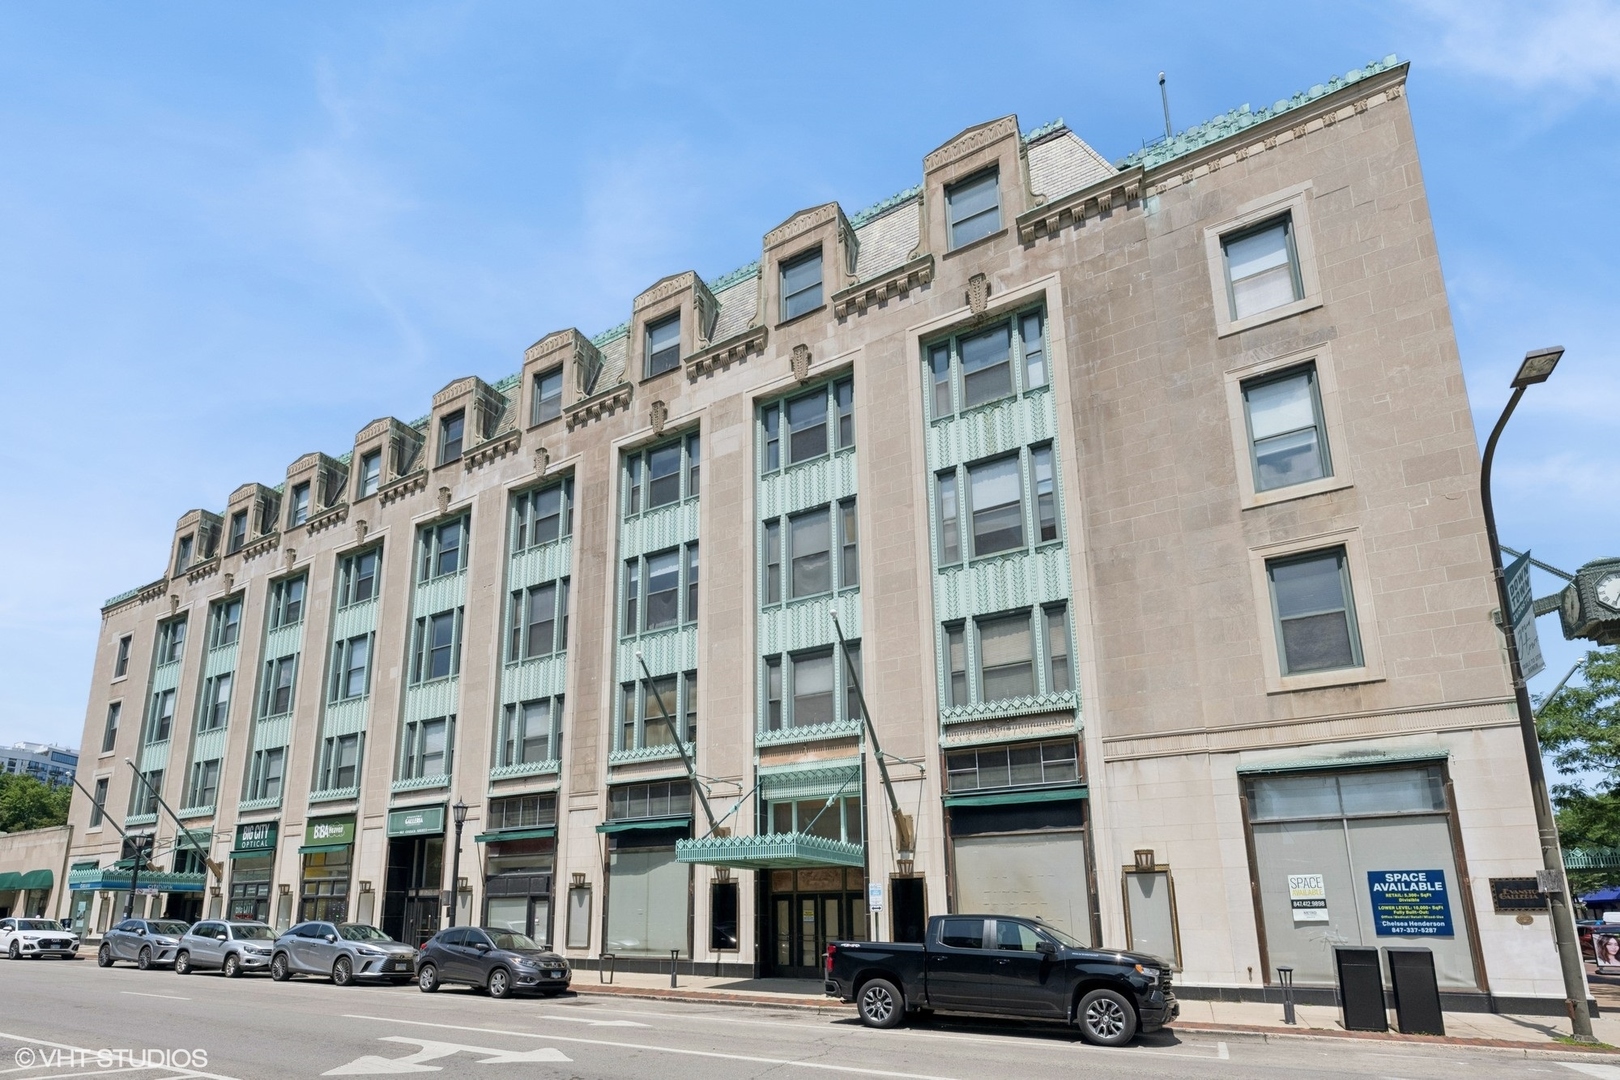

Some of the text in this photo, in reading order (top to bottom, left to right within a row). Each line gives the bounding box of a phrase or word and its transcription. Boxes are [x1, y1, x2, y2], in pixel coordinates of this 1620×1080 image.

[1509, 564, 1529, 596] DOWN
[1511, 577, 1530, 608] TOWN
[242, 823, 270, 840] BIG CITY
[241, 840, 268, 848] OPTICAL
[1290, 877, 1322, 889] SPACE
[1385, 873, 1427, 882] SPACE
[1373, 882, 1443, 892] AVAILABLE
